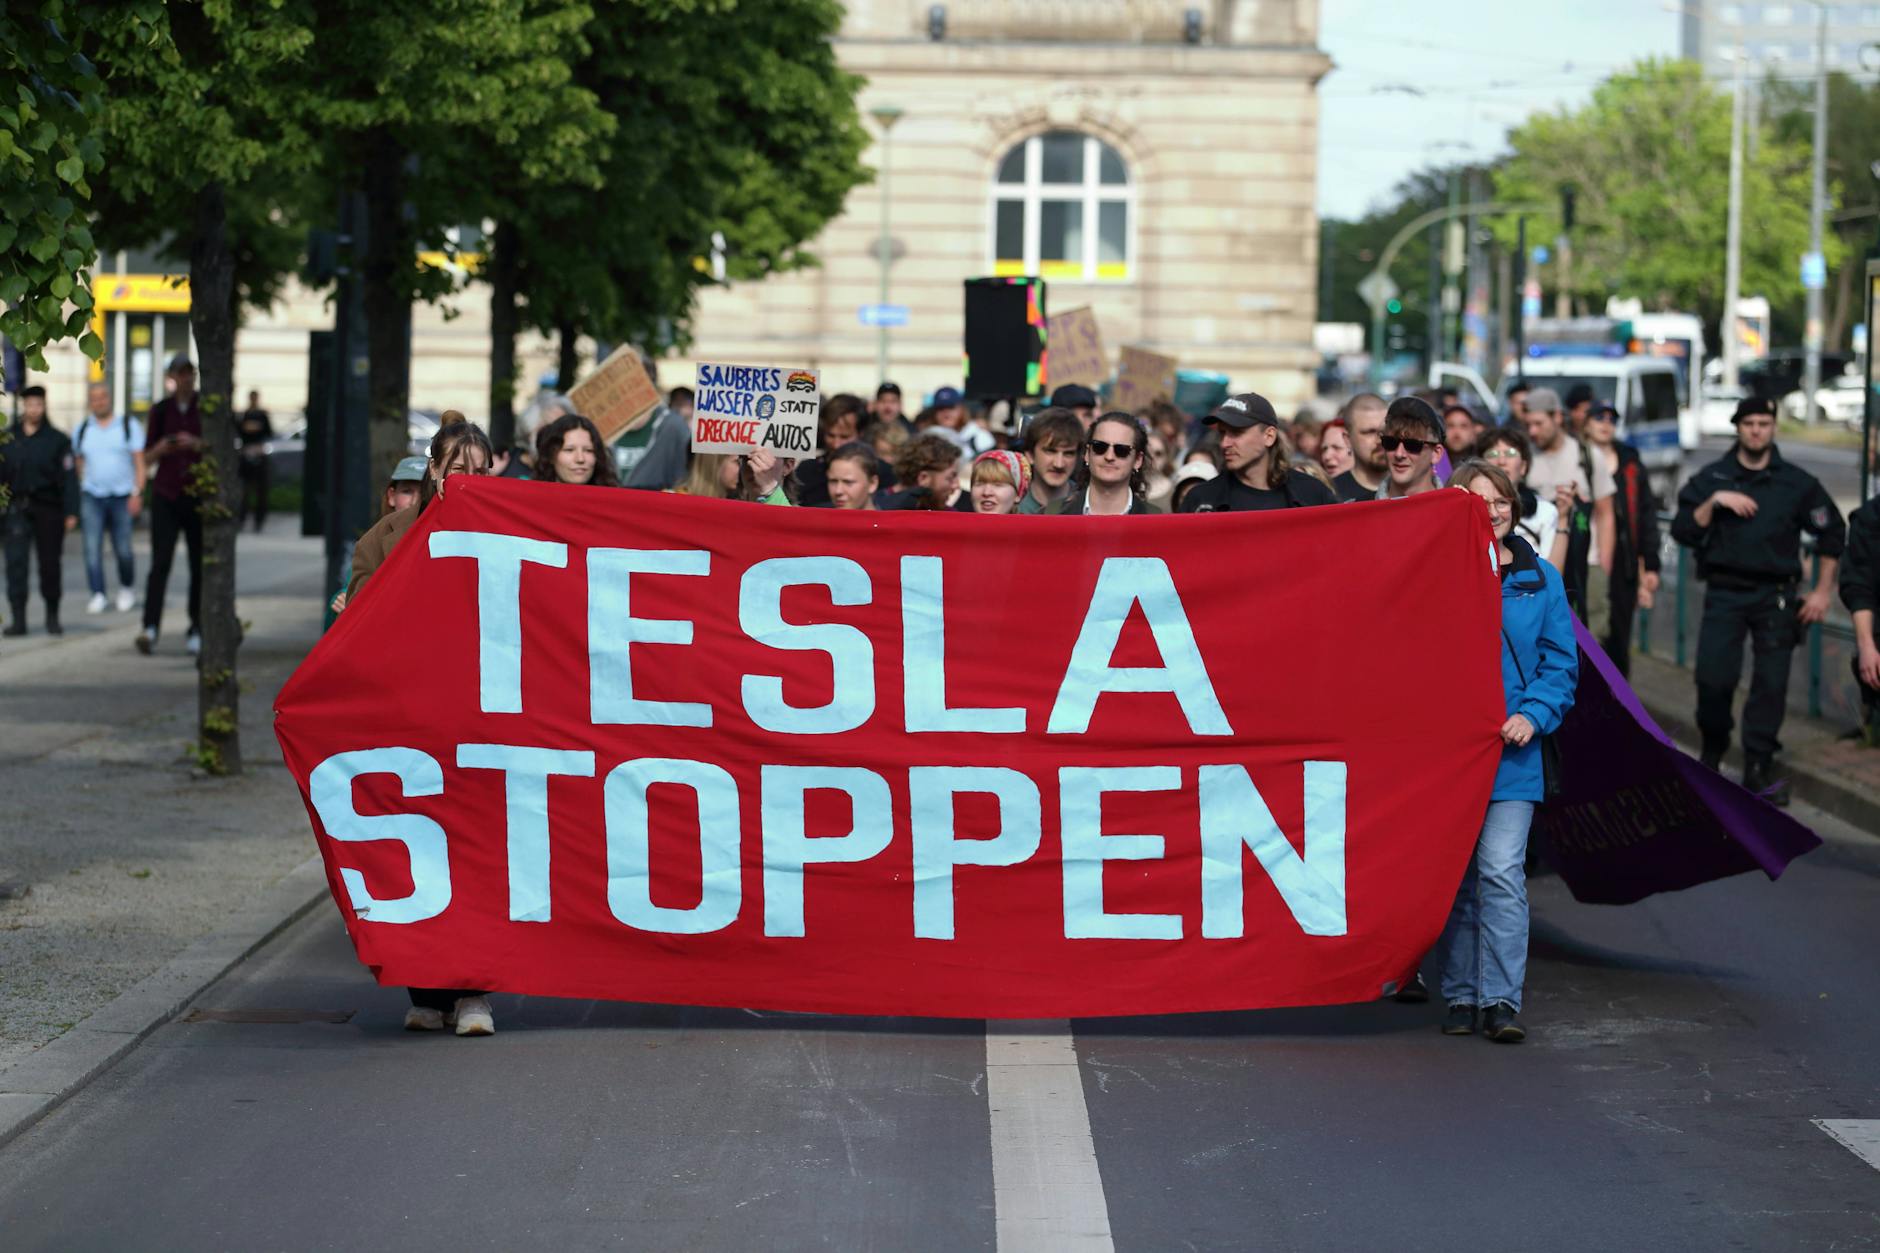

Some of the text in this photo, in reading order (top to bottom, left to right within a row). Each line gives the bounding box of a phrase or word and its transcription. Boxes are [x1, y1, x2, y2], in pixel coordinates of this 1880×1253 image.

[698, 365, 781, 391] SAUBERES
[697, 389, 817, 417] WASSER STATT
[696, 418, 813, 452] DRECKIGE AUTOS
[429, 531, 1232, 735] TESLA
[310, 744, 1347, 939] STOPPEN
